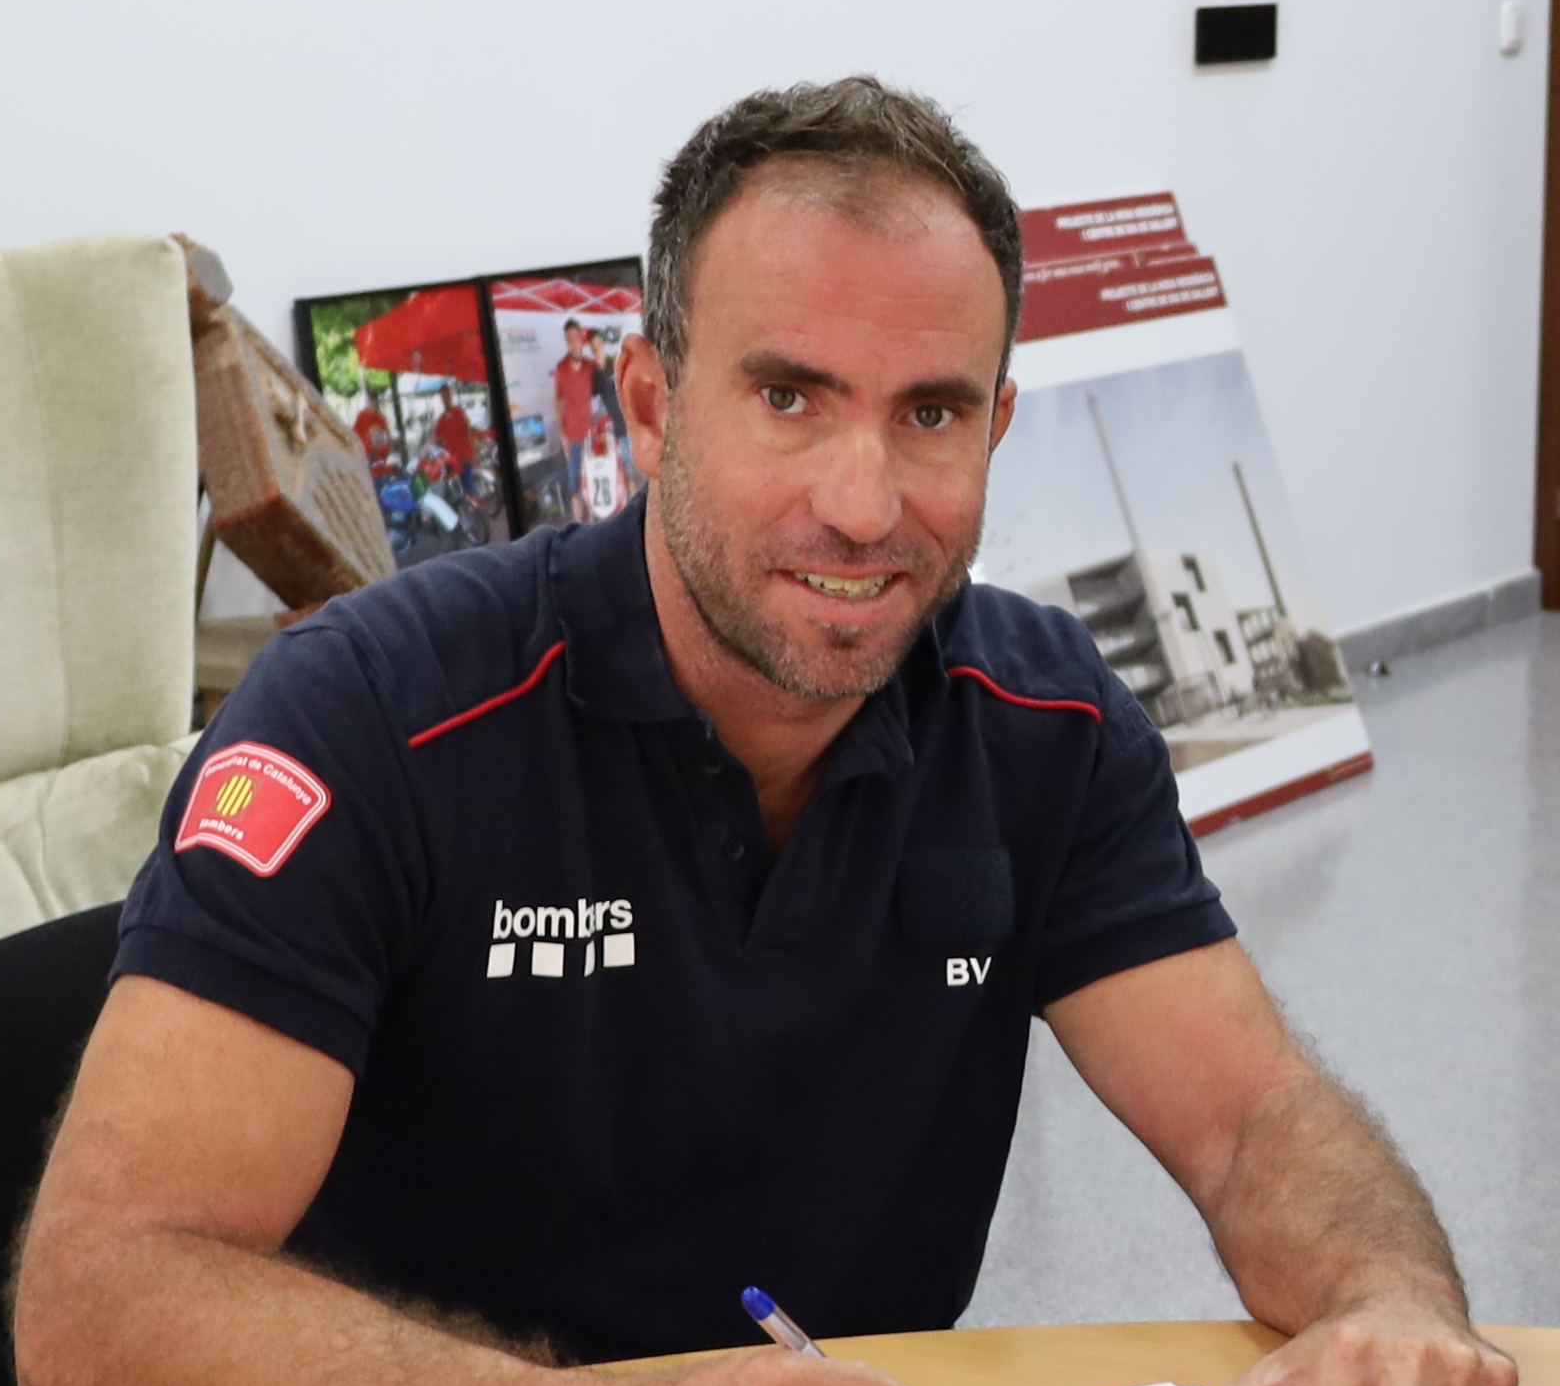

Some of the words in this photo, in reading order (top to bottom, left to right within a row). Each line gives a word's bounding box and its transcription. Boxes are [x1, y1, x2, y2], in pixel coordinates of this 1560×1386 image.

[248, 758, 262, 770] de
[263, 764, 312, 806] Catalunya
[492, 898, 634, 940] bombrs
[946, 956, 992, 986] BV
